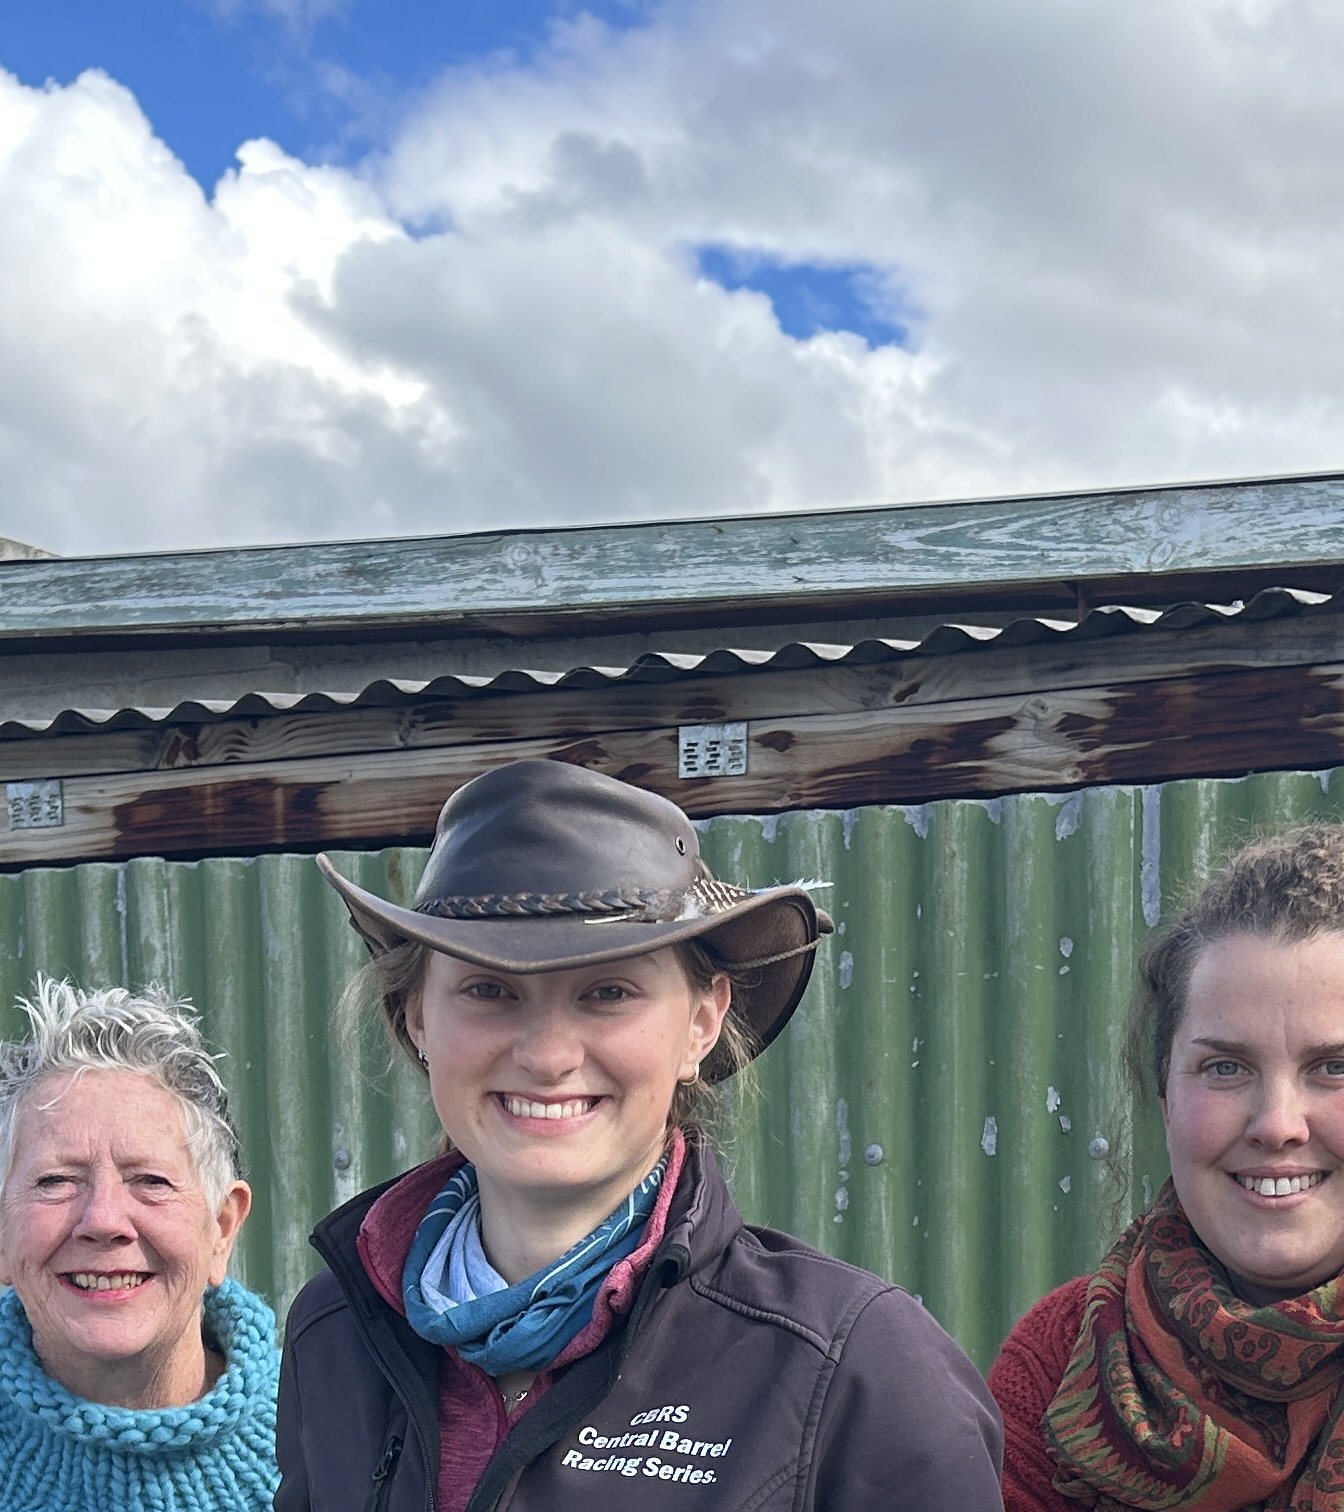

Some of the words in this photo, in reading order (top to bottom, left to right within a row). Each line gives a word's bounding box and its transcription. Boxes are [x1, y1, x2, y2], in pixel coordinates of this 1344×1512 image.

[629, 1404, 691, 1427] CBRS
[577, 1426, 660, 1450] Central
[659, 1430, 733, 1458] Barrel
[561, 1449, 643, 1477] Racing
[642, 1457, 718, 1485] Series.
